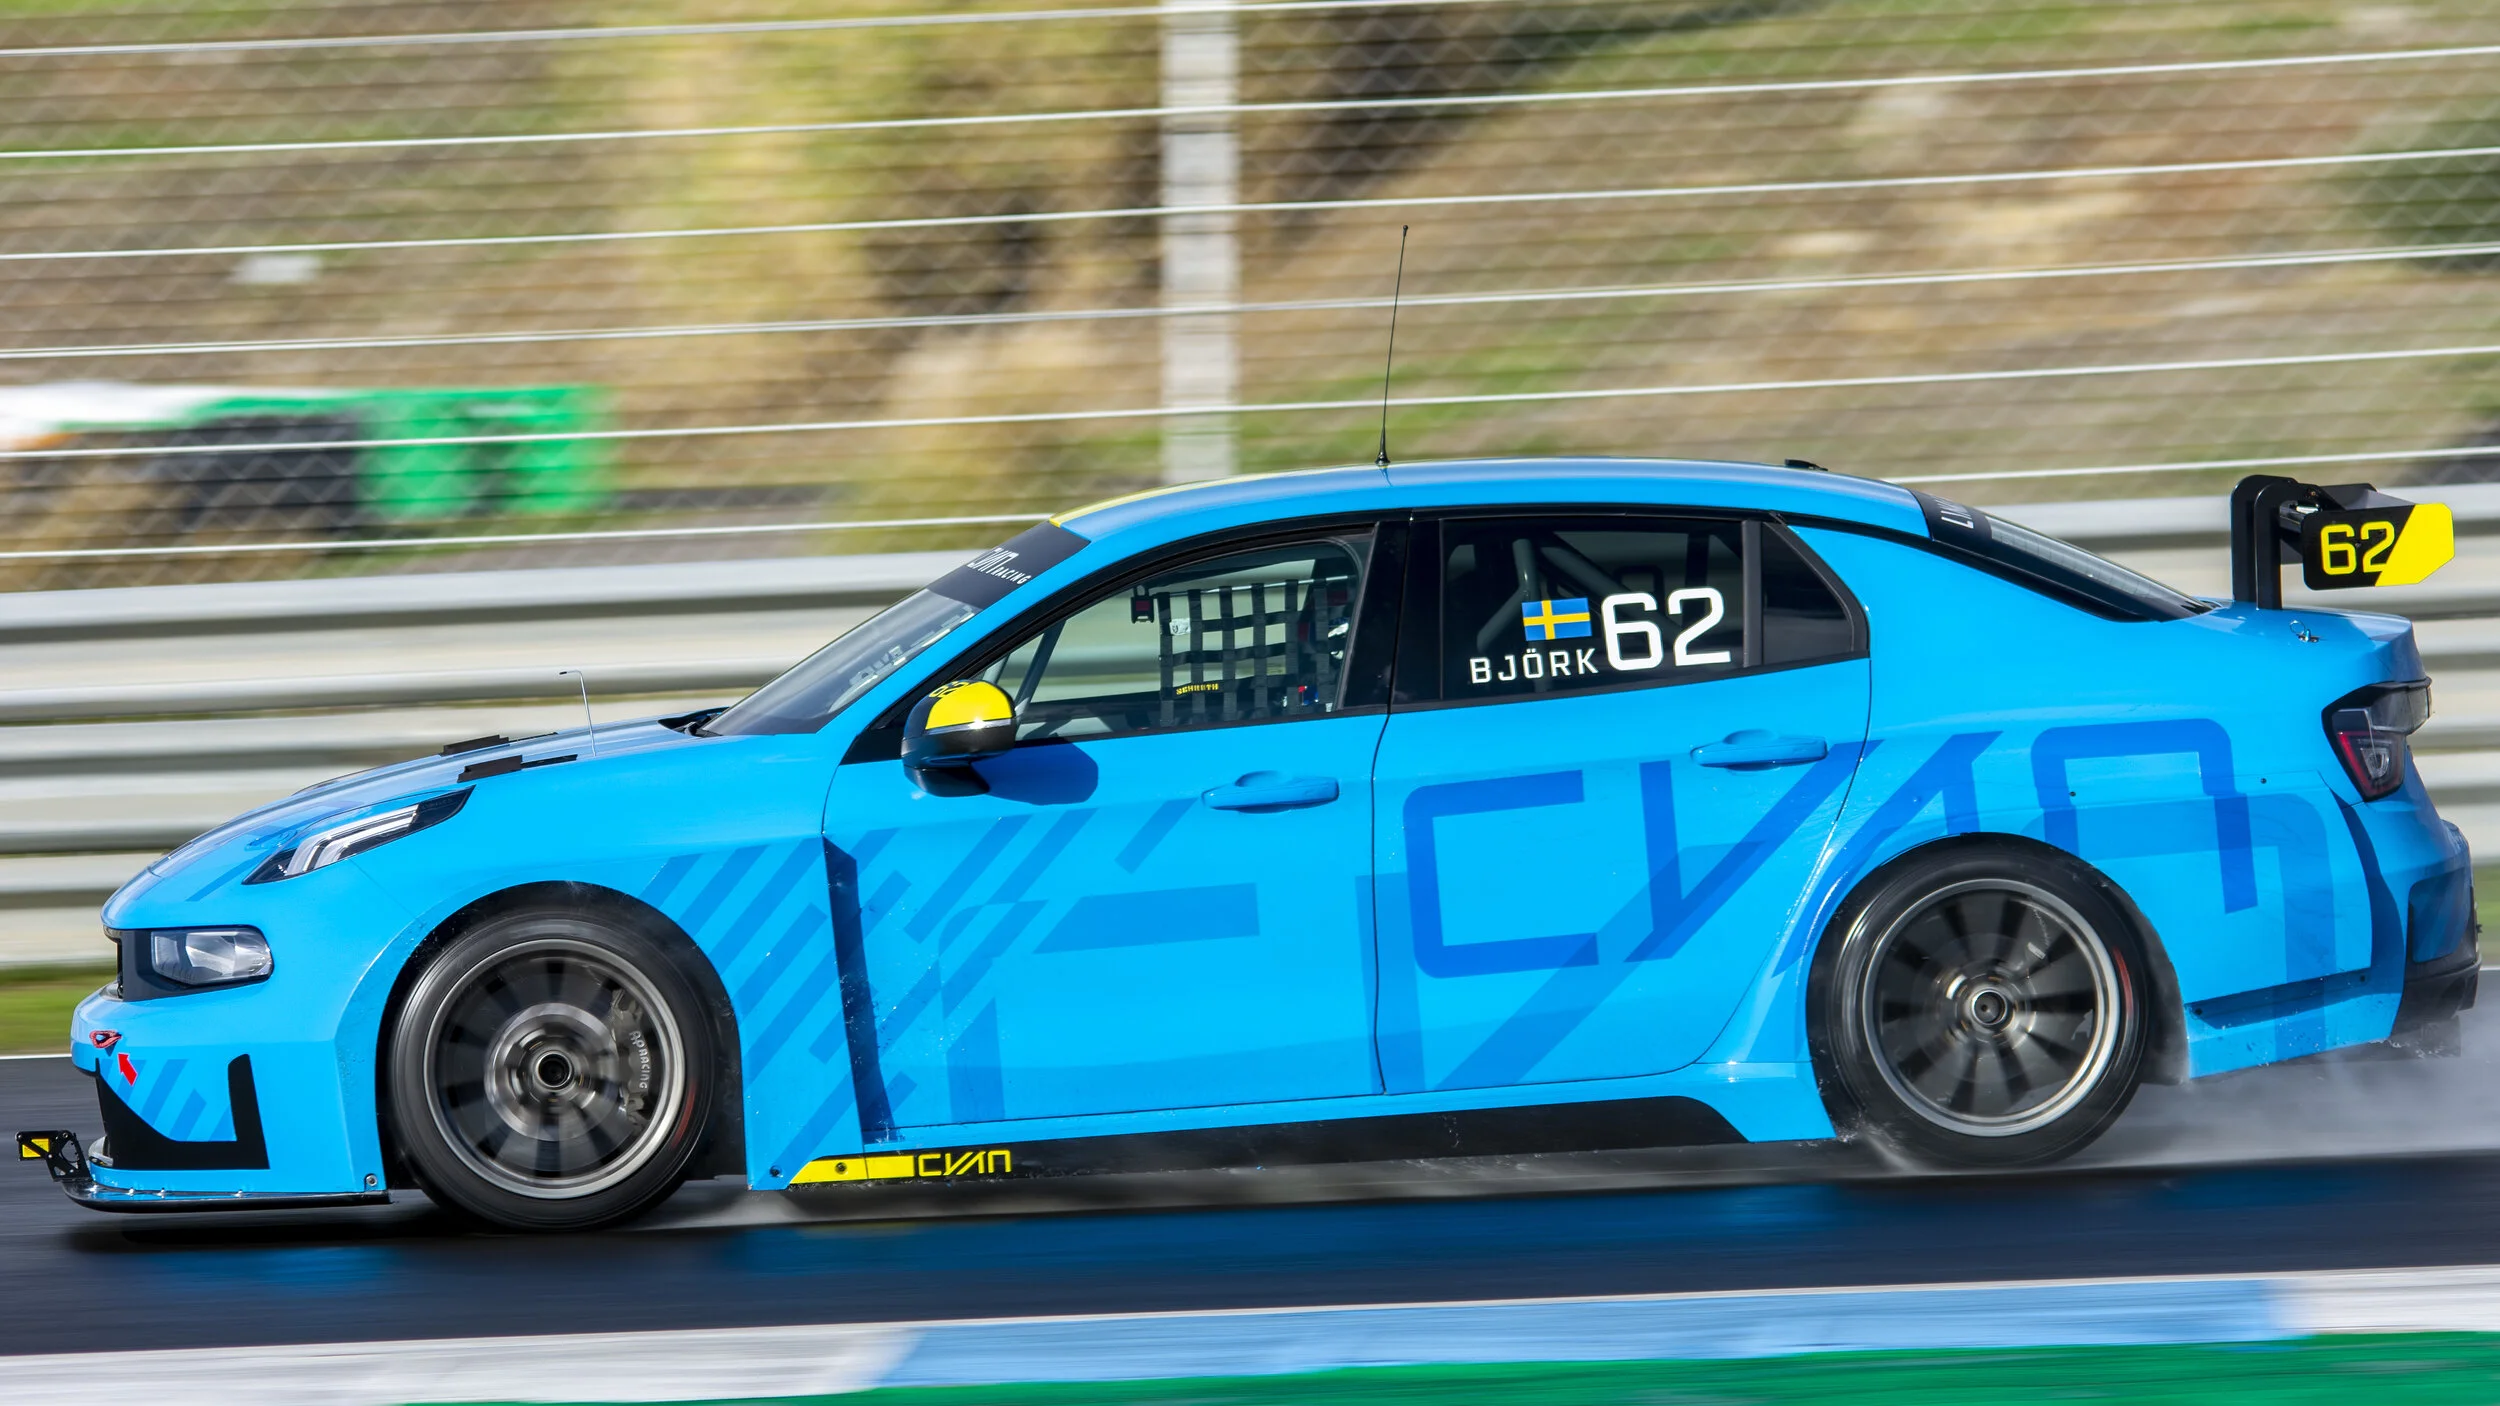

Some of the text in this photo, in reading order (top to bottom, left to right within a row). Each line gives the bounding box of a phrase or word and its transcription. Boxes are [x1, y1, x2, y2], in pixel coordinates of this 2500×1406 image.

[2320, 521, 2395, 575] 62
[991, 566, 1031, 585] RACING
[1601, 587, 1731, 671] 62
[1469, 647, 1599, 684] BJÖRK
[918, 1150, 1012, 1177] CYAN
